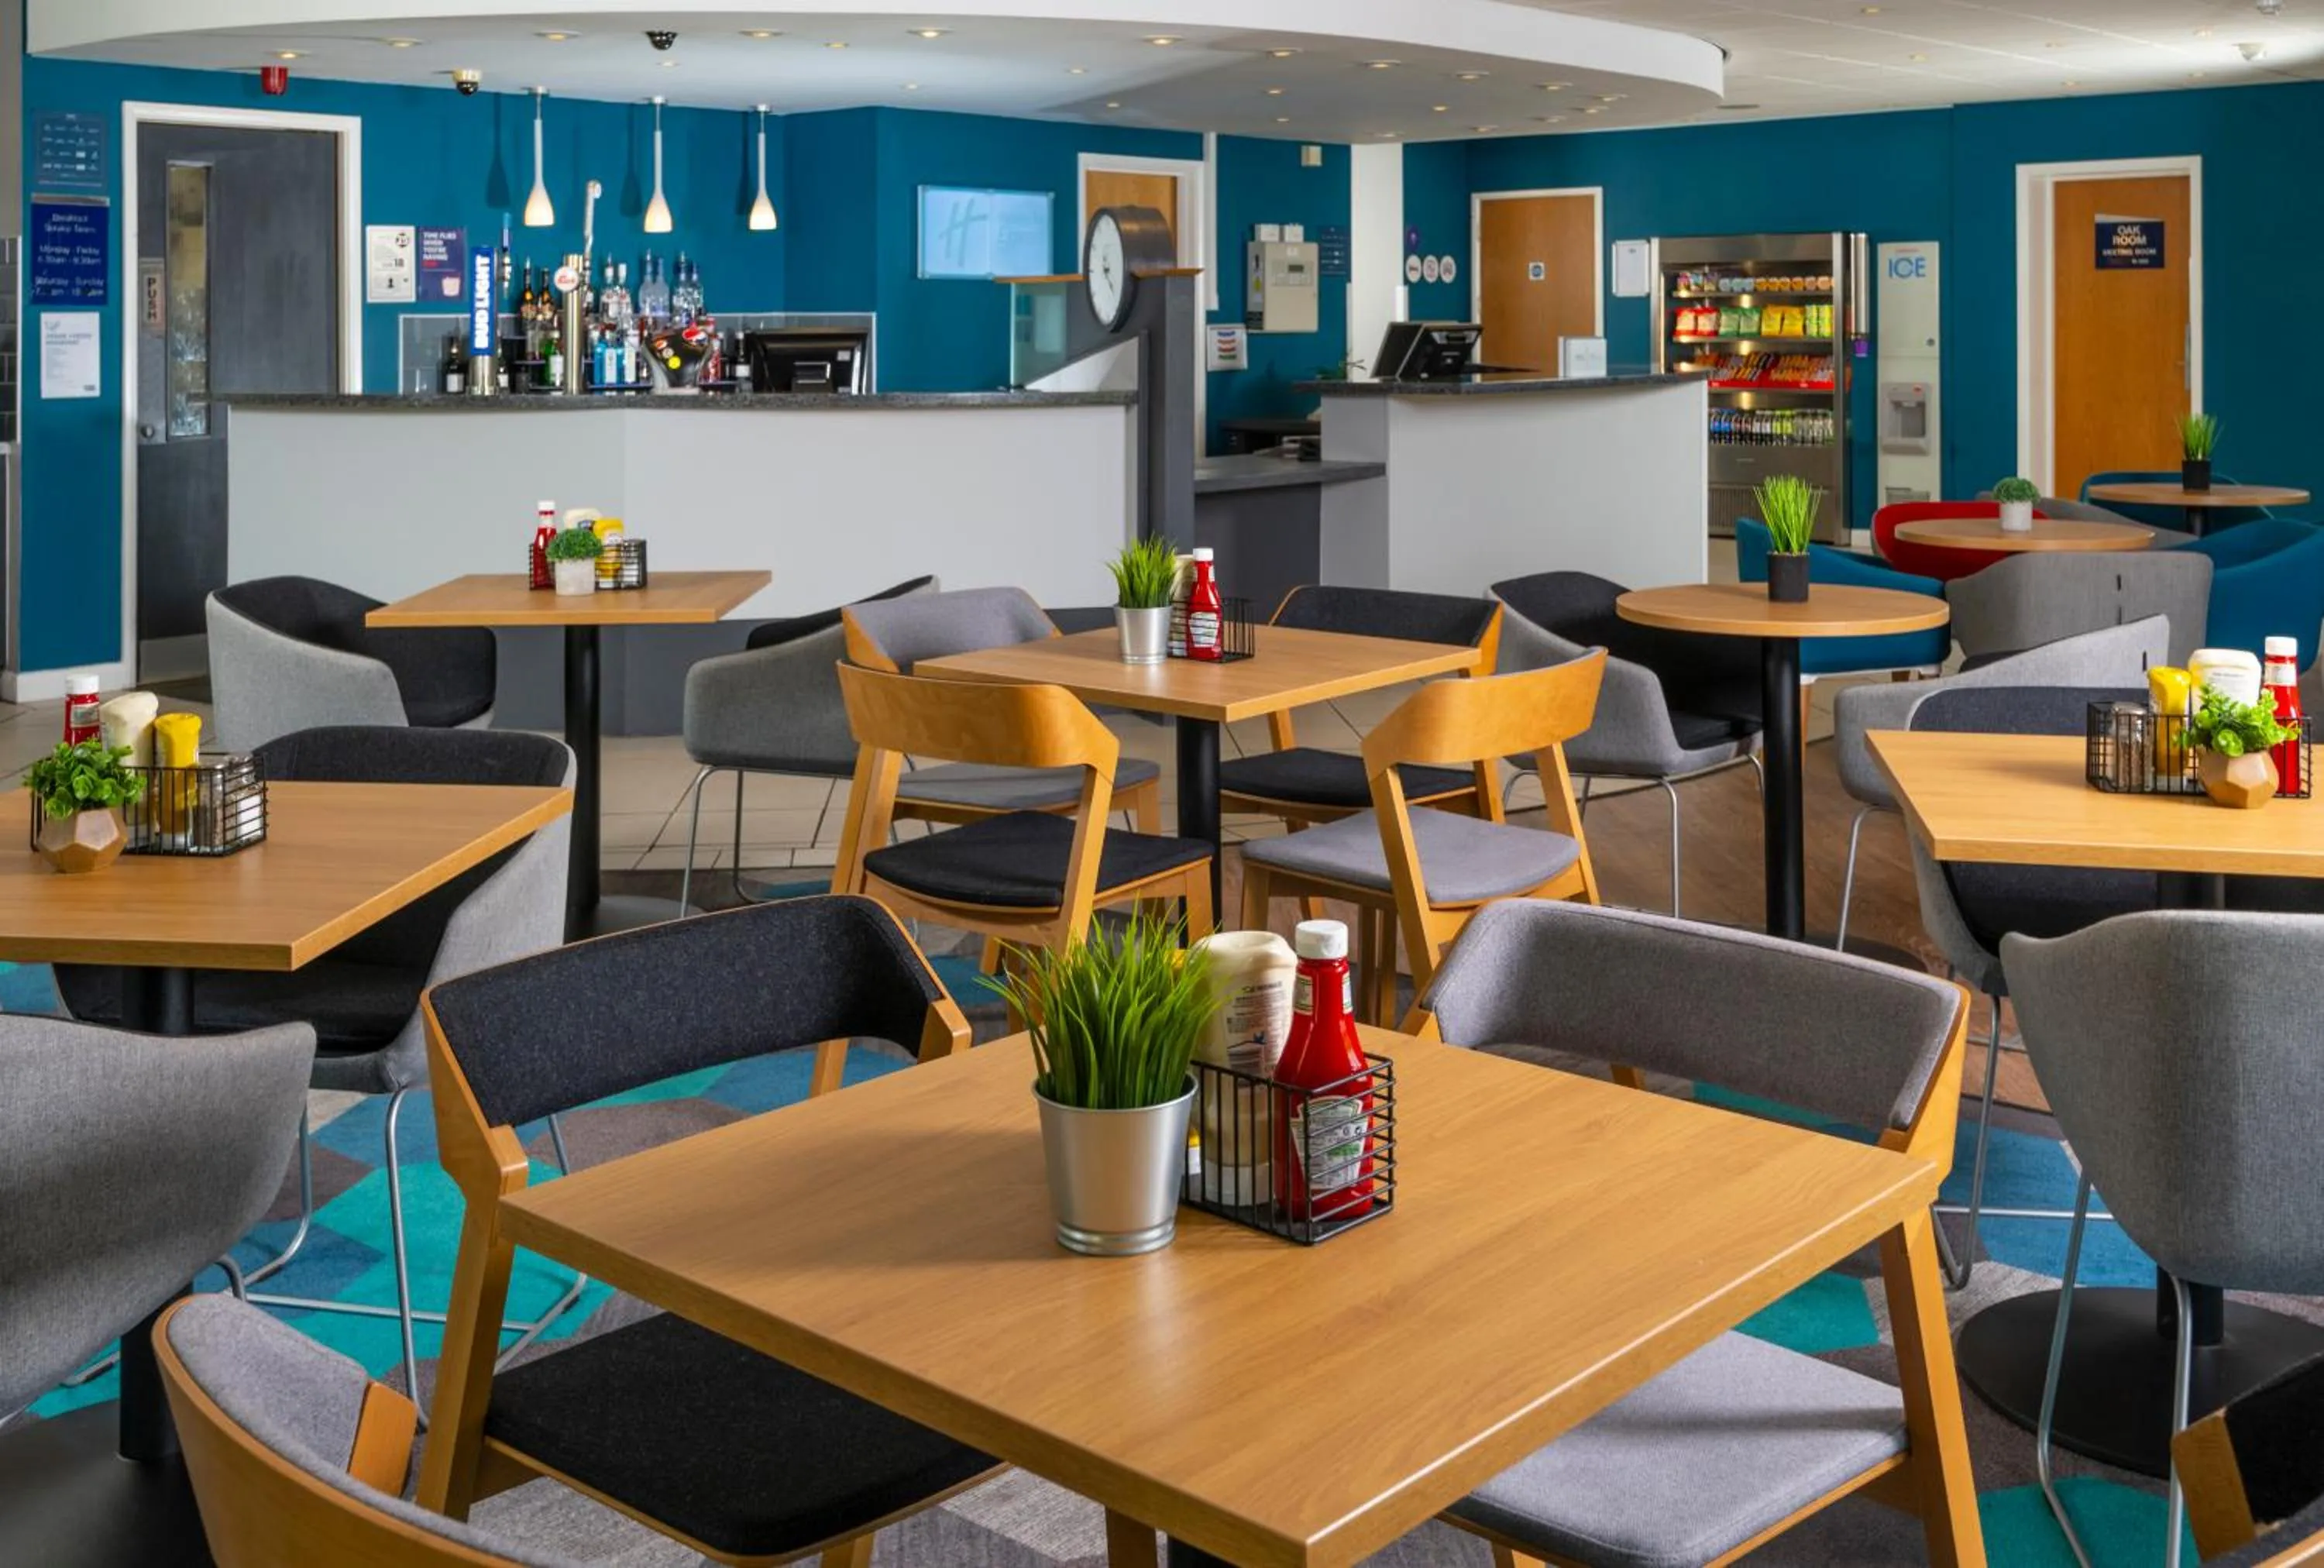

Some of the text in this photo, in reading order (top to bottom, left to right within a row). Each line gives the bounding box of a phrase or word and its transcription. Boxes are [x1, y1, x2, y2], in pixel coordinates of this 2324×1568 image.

[2113, 234, 2147, 246] ROOM
[2117, 225, 2141, 235] OAK
[1888, 256, 1927, 280] ICE
[147, 277, 158, 320] PUSH
[474, 254, 491, 349] BUD LIGHT
